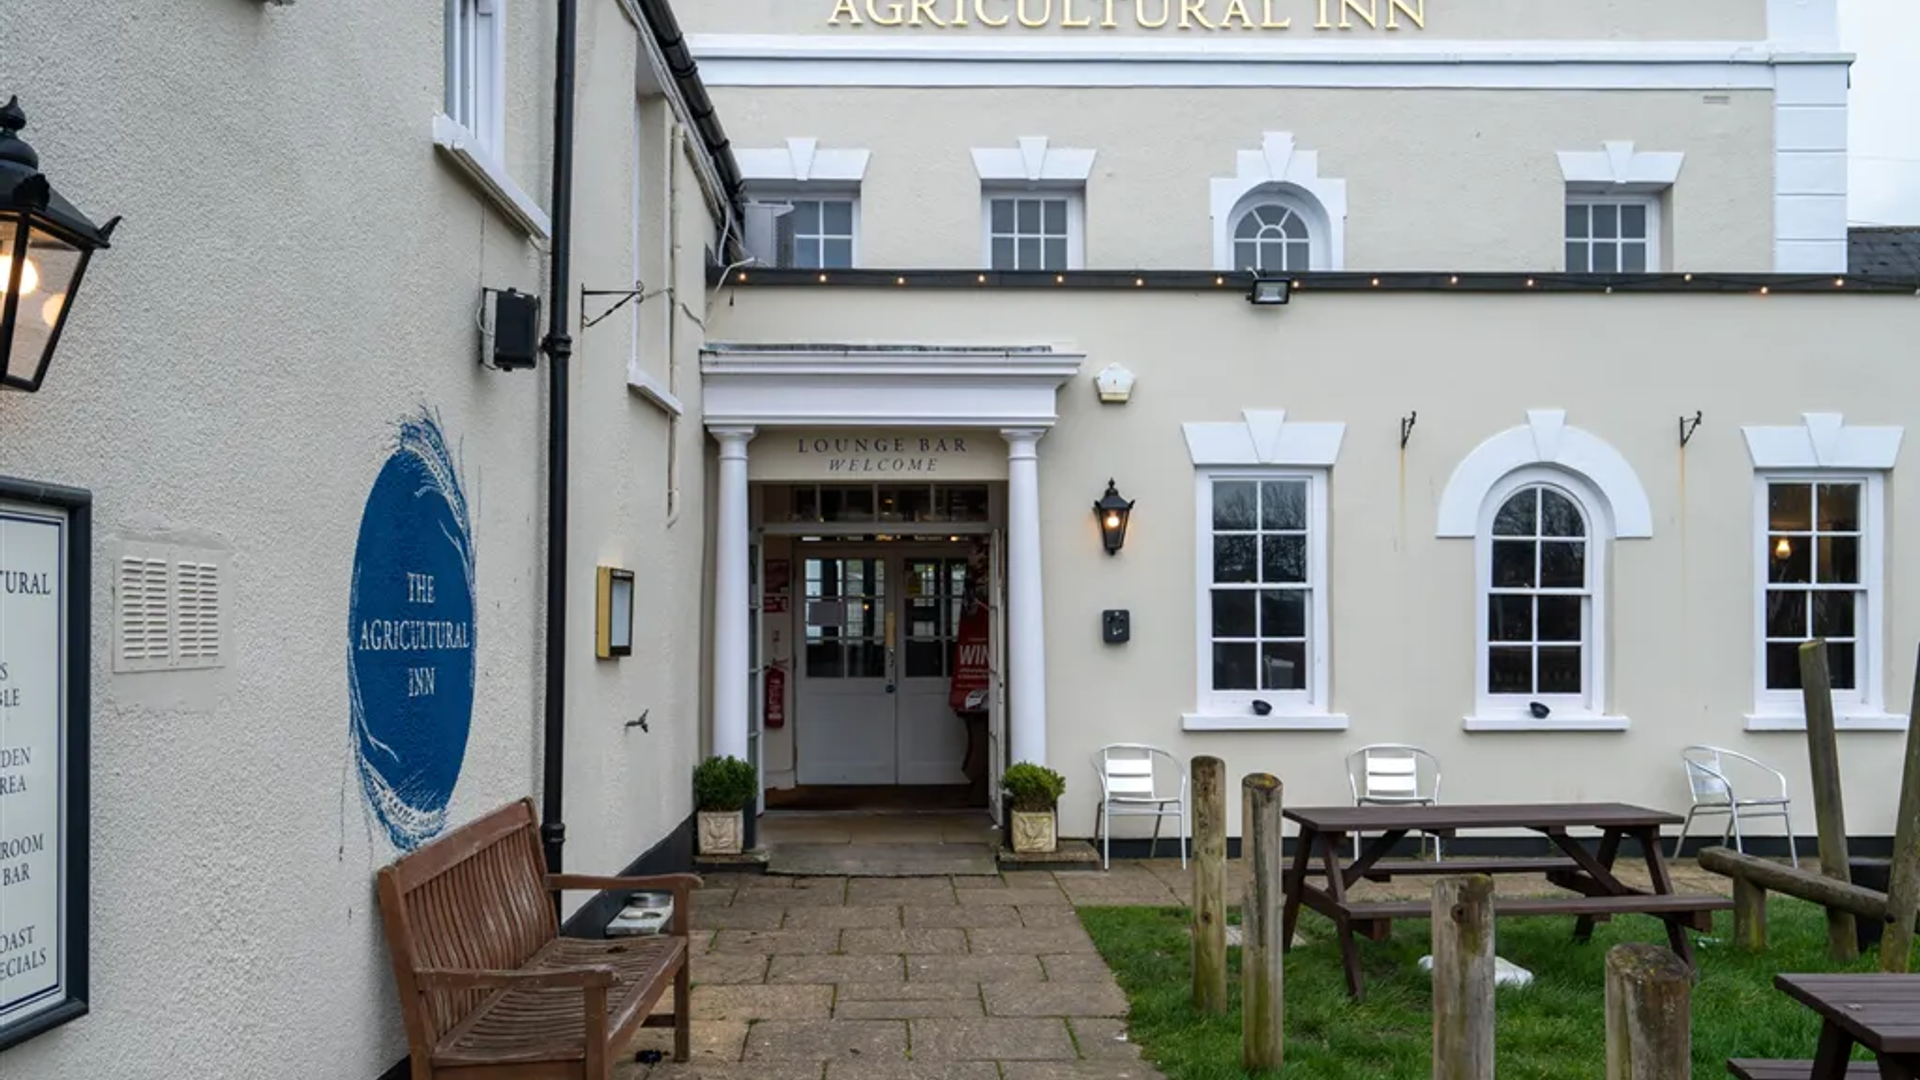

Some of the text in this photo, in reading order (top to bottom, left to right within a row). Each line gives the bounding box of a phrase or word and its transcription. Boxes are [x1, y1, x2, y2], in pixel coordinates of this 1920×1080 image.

[827, 0, 1428, 29] AGRICULTURAL INN
[797, 437, 968, 453] LOUNGE BAR
[828, 458, 939, 472] WELCOME
[0, 570, 51, 595] URAL
[407, 572, 436, 604] THE
[359, 619, 471, 650] AGRICULTURAL
[408, 667, 436, 697] INN
[2, 862, 31, 886] BAR
